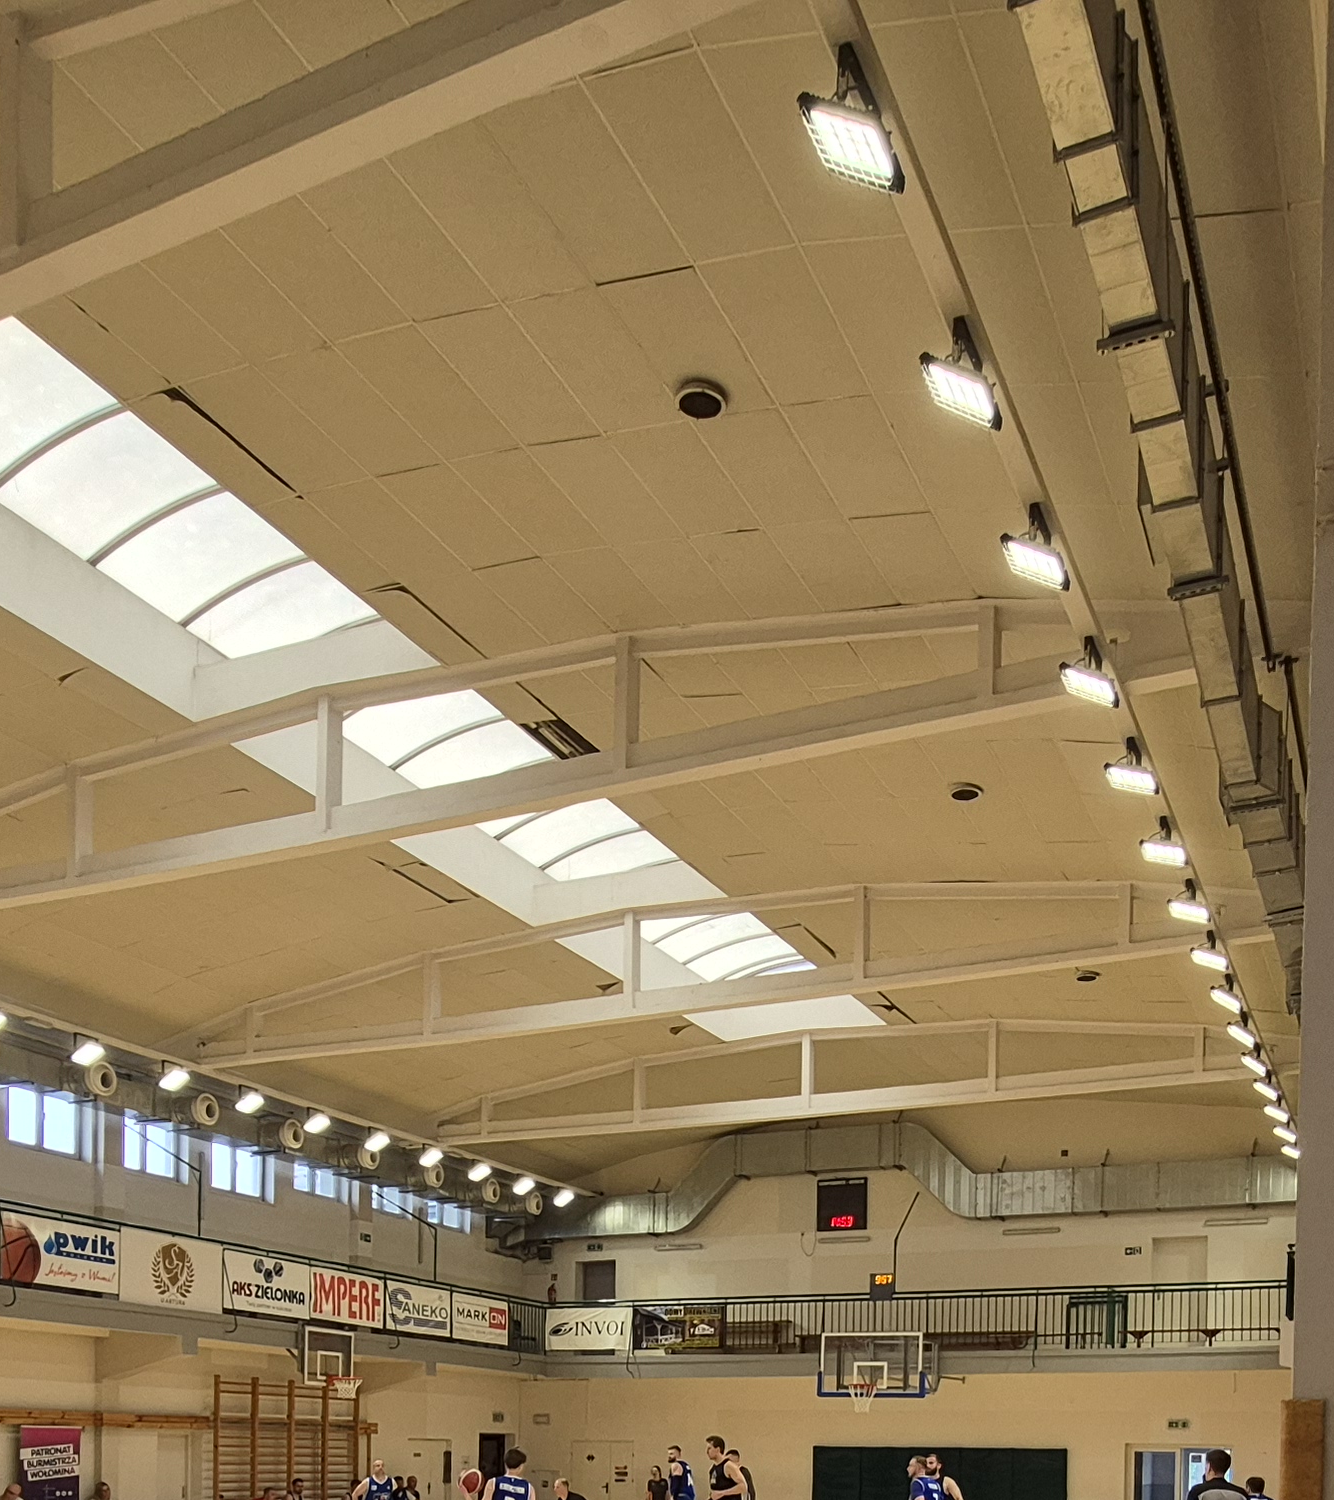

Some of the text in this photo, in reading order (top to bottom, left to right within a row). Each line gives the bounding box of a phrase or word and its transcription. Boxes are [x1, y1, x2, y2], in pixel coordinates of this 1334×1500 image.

[231, 1280, 306, 1306] AKS ZIELONKA
[456, 1306, 506, 1325] MARK ON
[30, 1445, 72, 1458] PATRONAT
[27, 1455, 77, 1469] BURMISTRZA
[29, 1466, 76, 1480] WOŁOMINA
